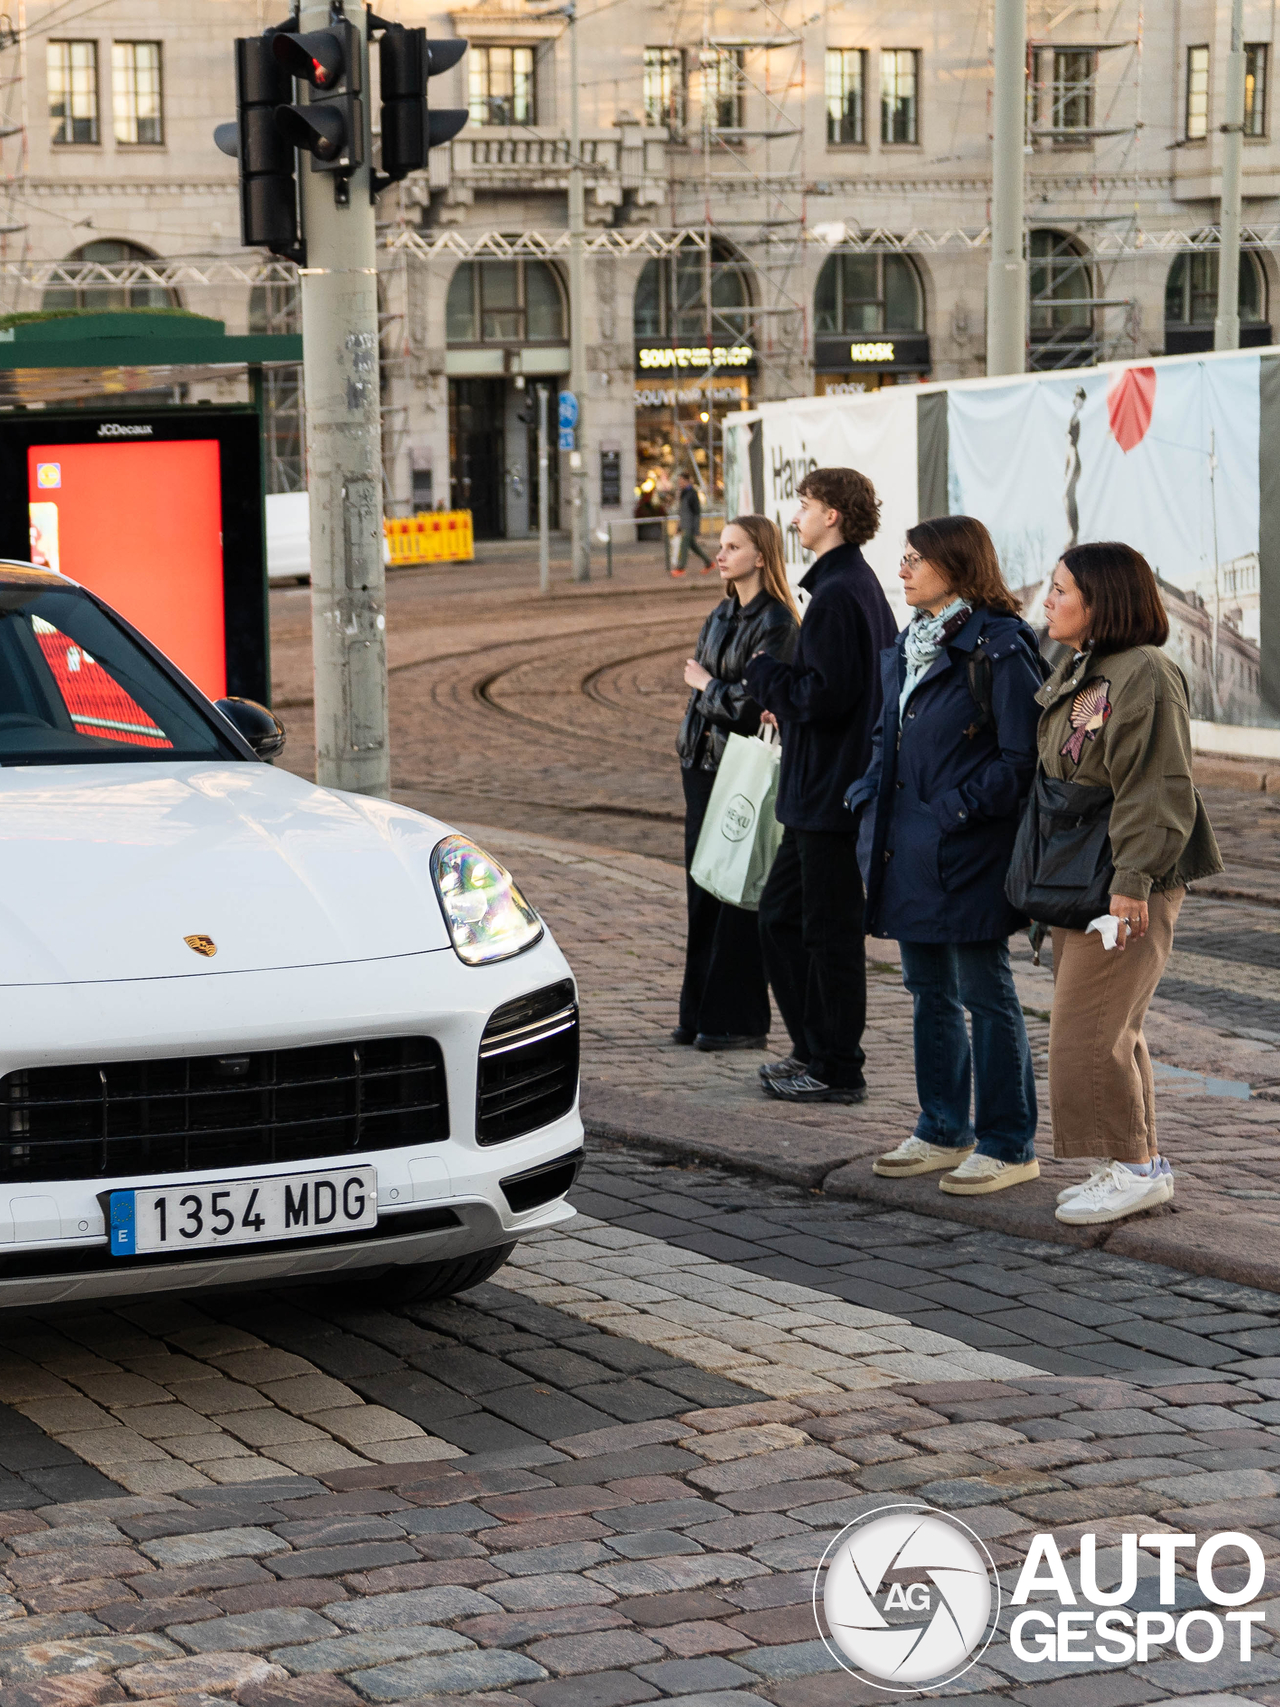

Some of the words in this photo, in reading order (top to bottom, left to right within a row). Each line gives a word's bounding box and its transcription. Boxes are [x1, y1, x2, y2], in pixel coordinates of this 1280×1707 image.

[851, 342, 894, 361] KIOSK
[97, 424, 153, 436] JCDecaux
[154, 1188, 266, 1242] 1354
[285, 1177, 365, 1228] MDG
[118, 1229, 129, 1243] E
